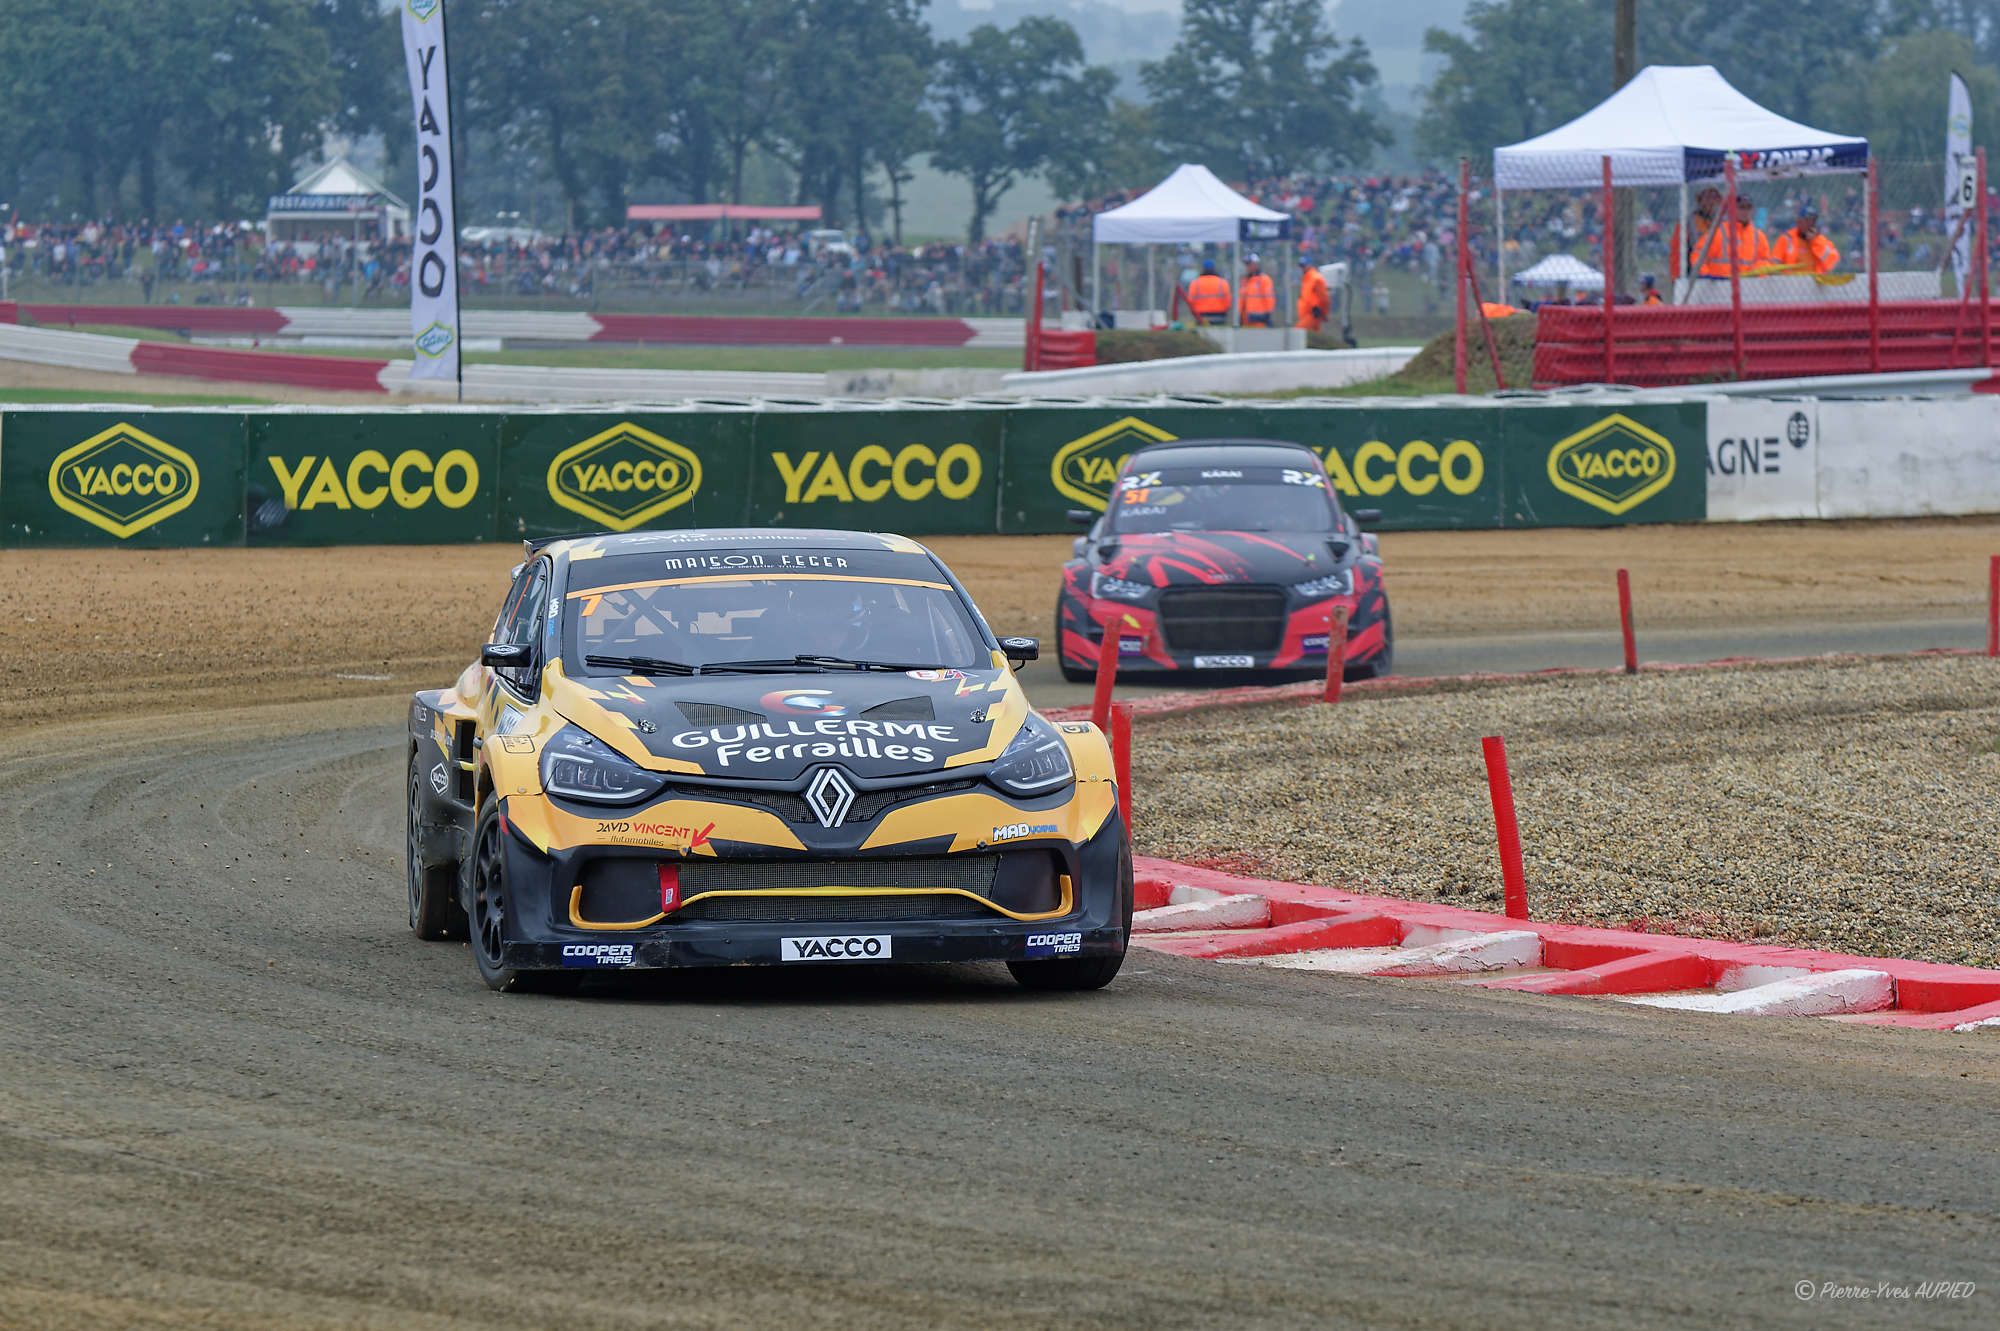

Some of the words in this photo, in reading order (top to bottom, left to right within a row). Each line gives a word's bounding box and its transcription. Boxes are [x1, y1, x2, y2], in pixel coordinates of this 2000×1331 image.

[1963, 176, 1973, 201] 6
[73, 462, 178, 496] YACCO
[572, 459, 680, 493] YACCO
[771, 443, 983, 504] YACCO
[1311, 440, 1484, 497] ACCO
[1571, 449, 1661, 480] YACCO
[268, 448, 480, 511] YACCO
[672, 719, 959, 748] GUILLERME
[716, 737, 934, 766] Ferrailles
[633, 823, 690, 839] VINCENT
[562, 944, 633, 957] COOPER
[792, 938, 881, 958] YACCO
[1027, 933, 1081, 947] COOPER
[1054, 945, 1080, 953] TIRES
[596, 955, 632, 964] TIRES
